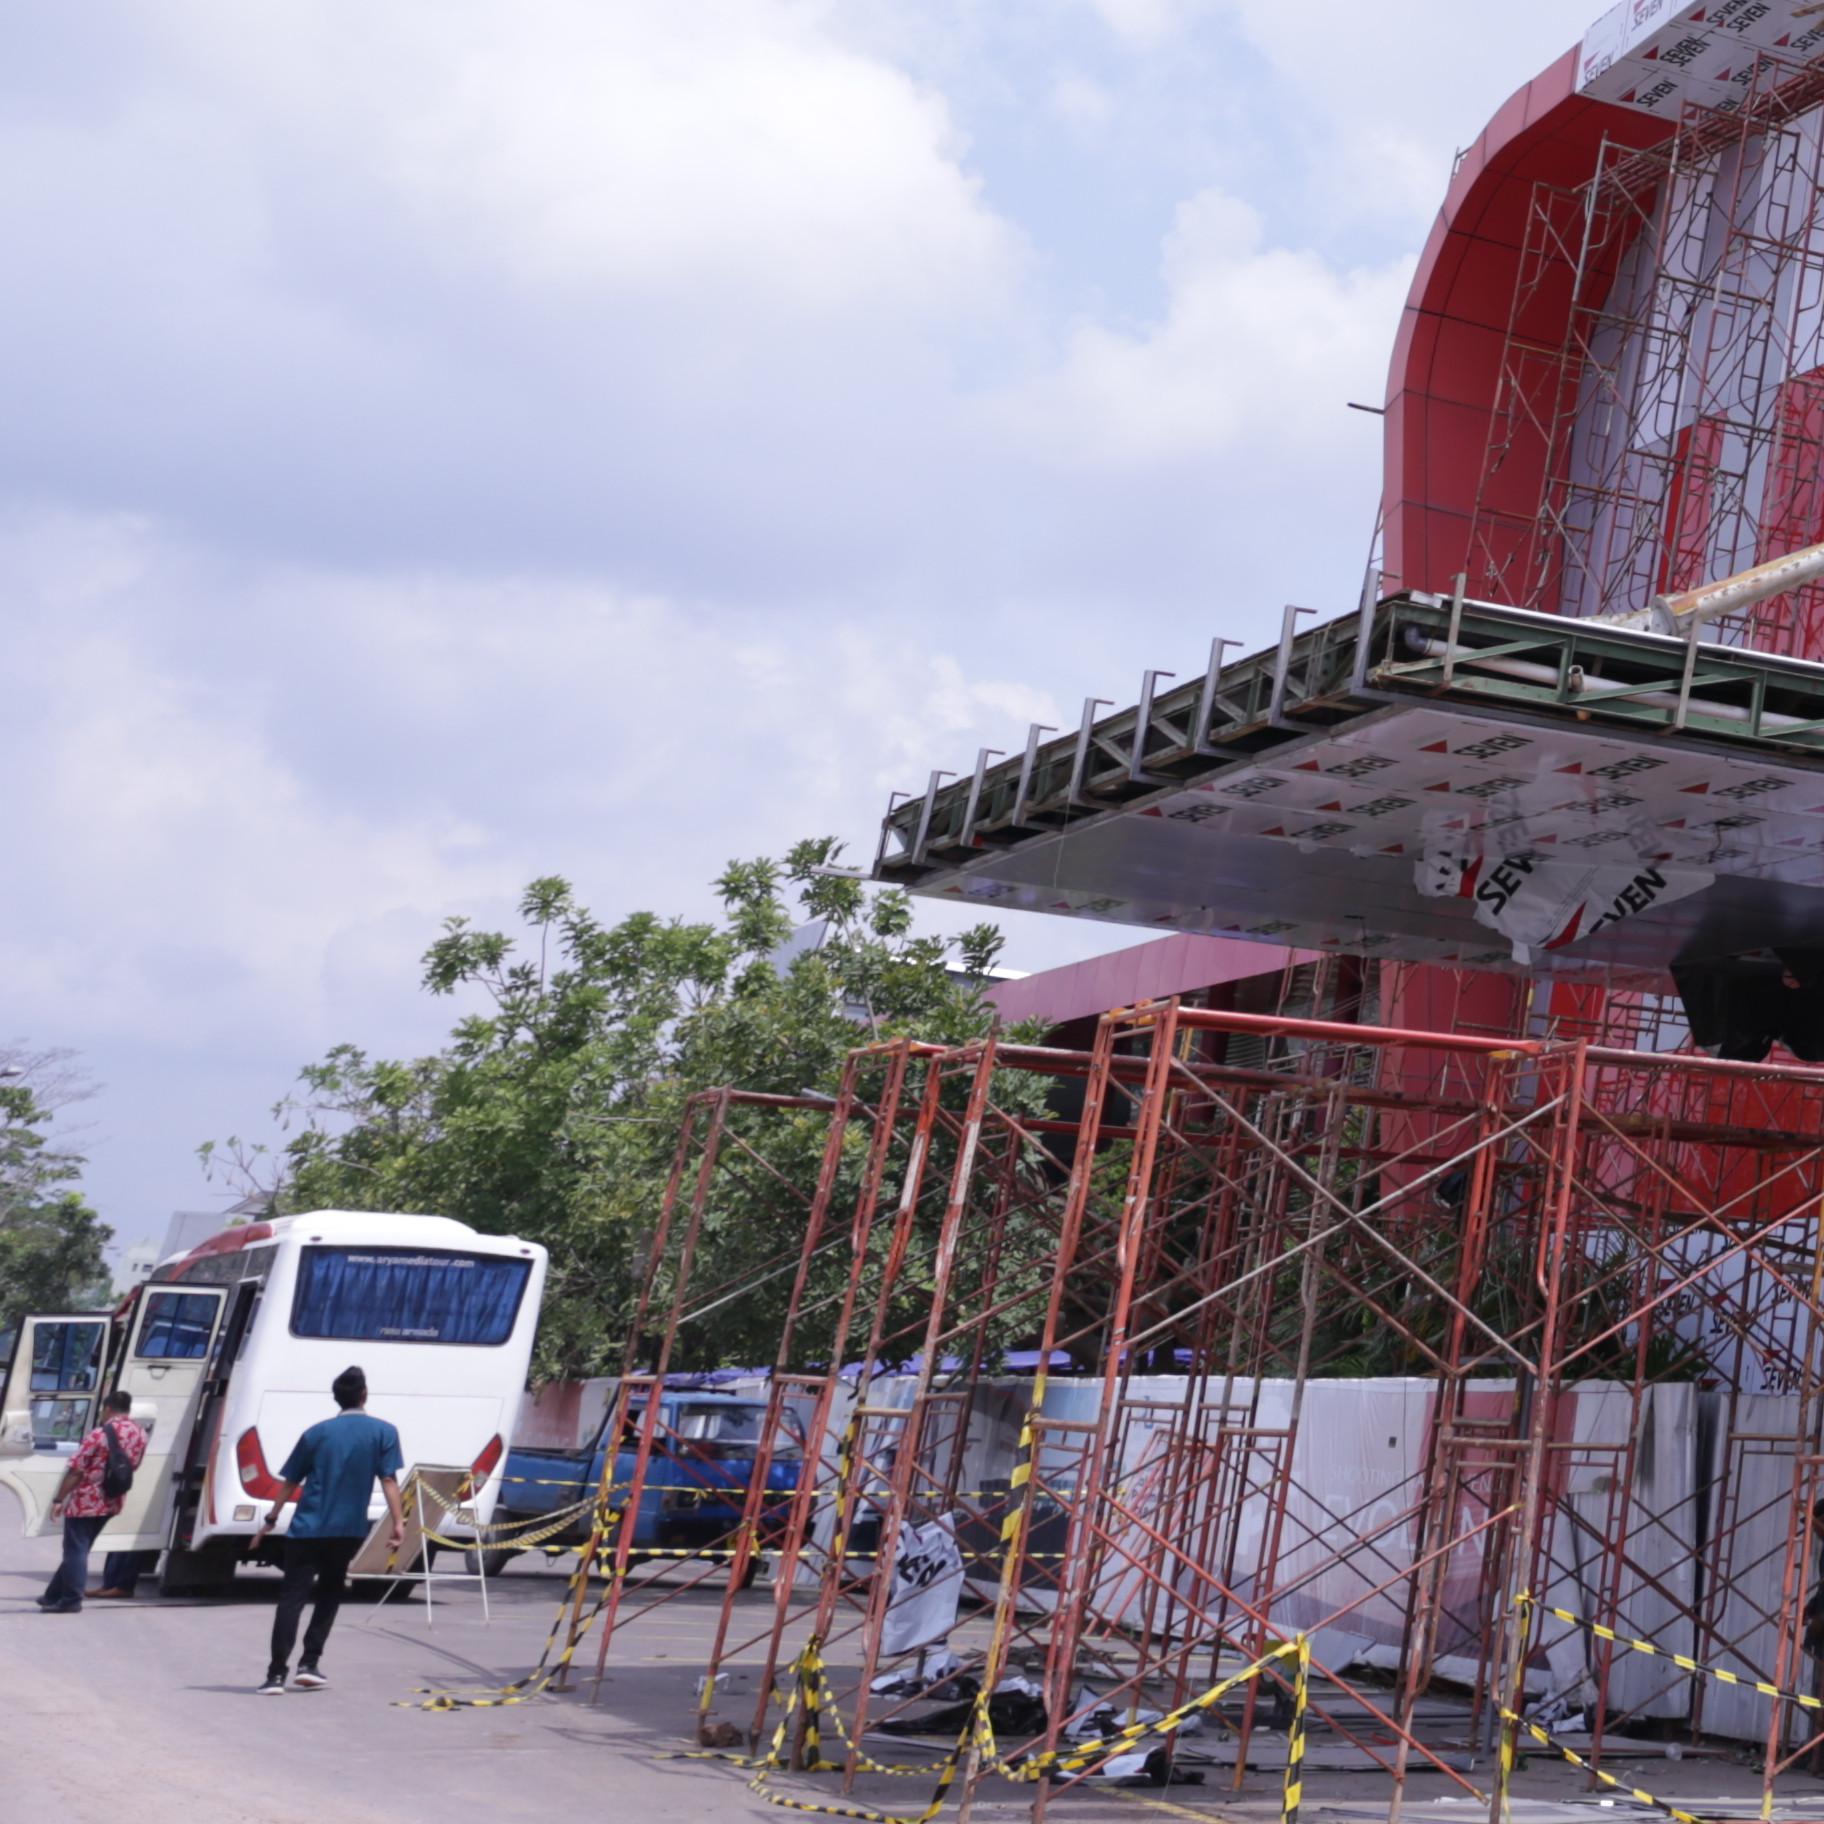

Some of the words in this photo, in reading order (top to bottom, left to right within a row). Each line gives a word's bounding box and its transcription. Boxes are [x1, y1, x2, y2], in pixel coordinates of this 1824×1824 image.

[1726, 2, 1771, 32] SEVEN
[1636, 80, 1678, 107] SEVEN
[1453, 735, 1534, 759] SEVEN
[1586, 754, 1668, 780] SEVEN
[1712, 775, 1794, 799] SEVEN
